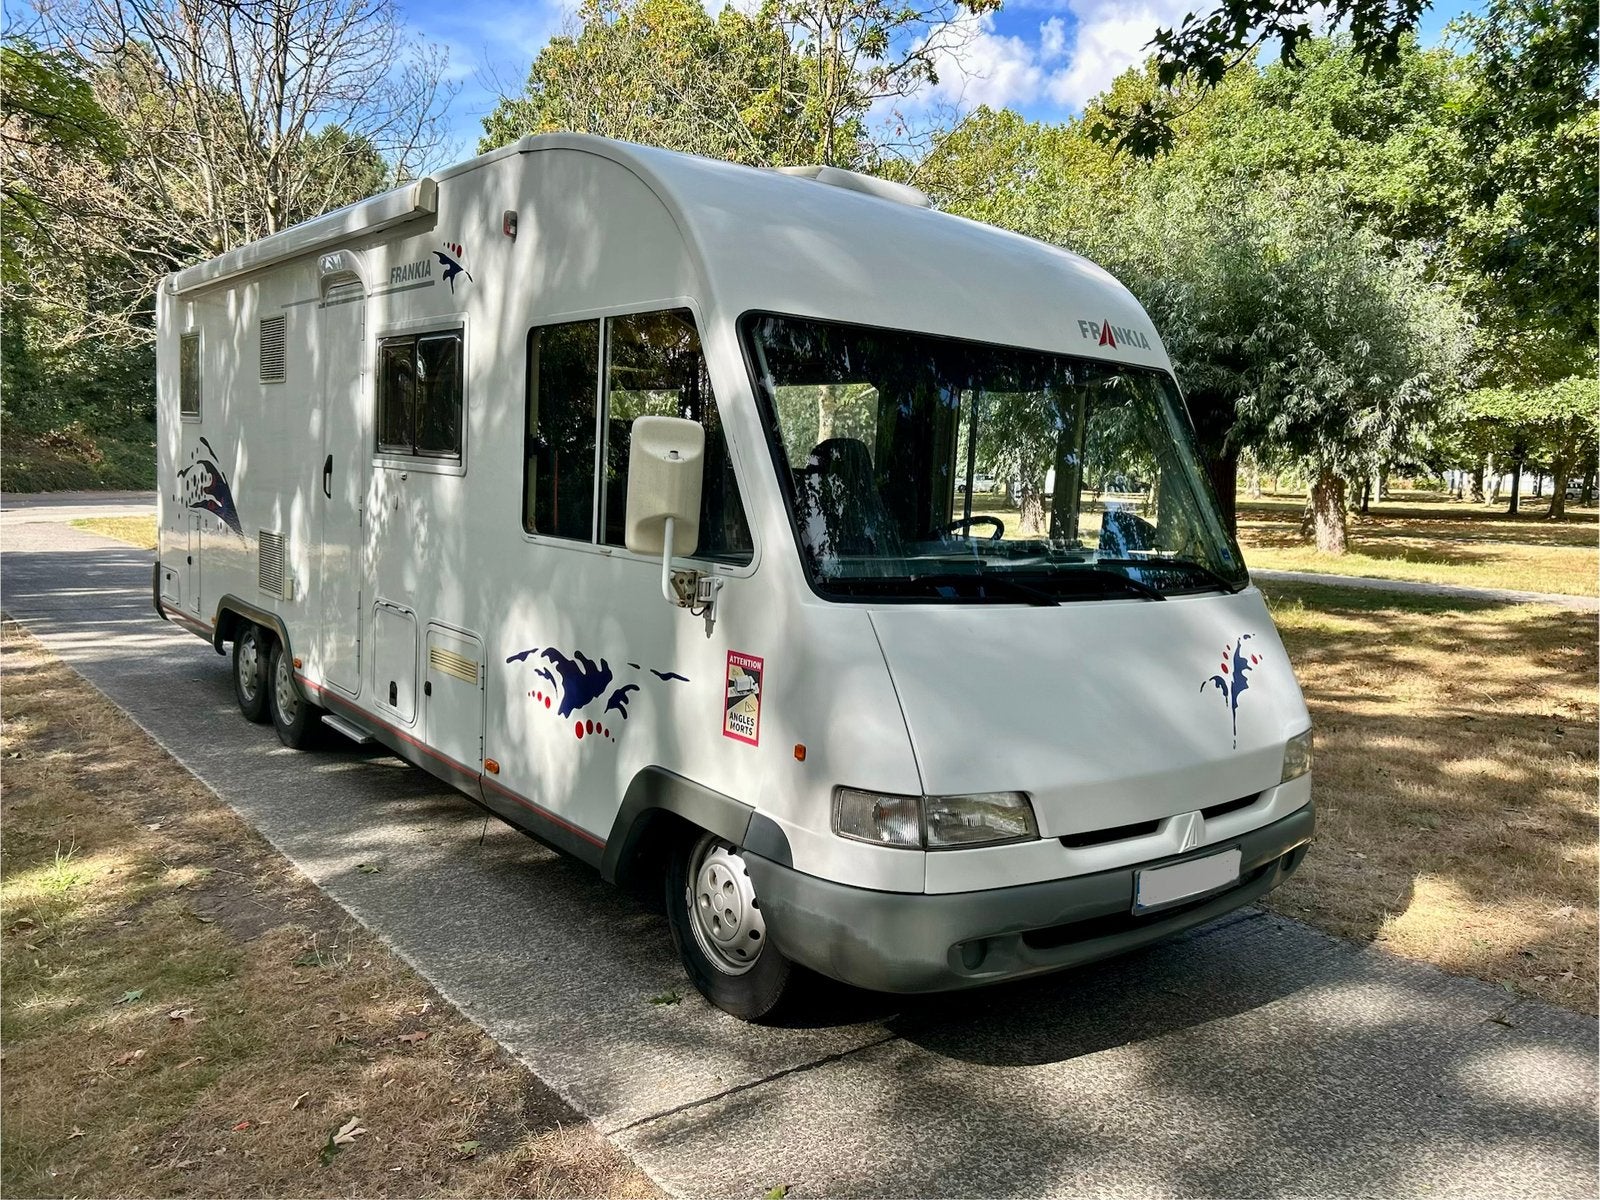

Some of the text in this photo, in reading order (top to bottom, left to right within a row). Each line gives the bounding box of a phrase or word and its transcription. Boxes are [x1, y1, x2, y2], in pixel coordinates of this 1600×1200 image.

[390, 259, 431, 284] FRANKIA
[1078, 319, 1151, 350] FRANKIA
[729, 655, 762, 670] ATTENTION
[728, 711, 754, 727] ANGLES
[729, 721, 753, 736] MORTS
